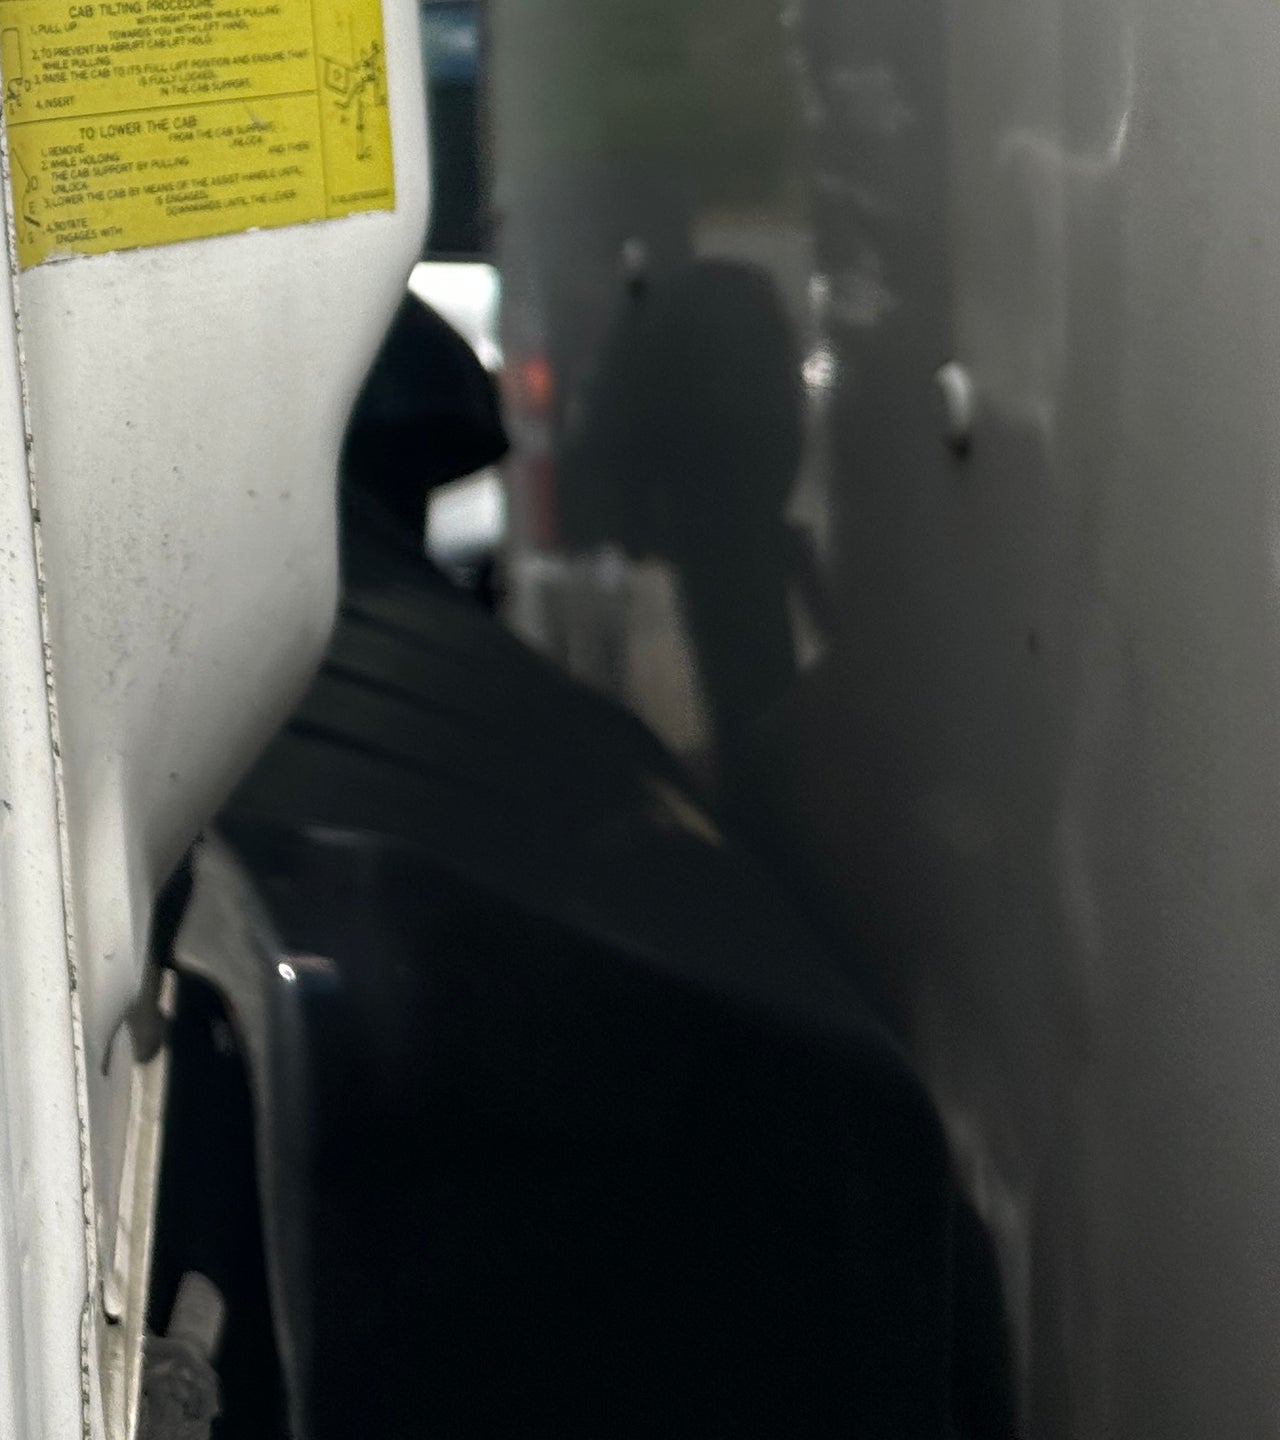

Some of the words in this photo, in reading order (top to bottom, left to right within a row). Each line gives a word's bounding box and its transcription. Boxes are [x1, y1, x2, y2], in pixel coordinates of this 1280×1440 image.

[68, 4, 95, 19] CAB
[98, 1, 143, 16] TILTING
[63, 21, 79, 32] UP
[41, 47, 53, 59] TO
[53, 44, 97, 57] PREVENT
[97, 43, 109, 54] AN
[42, 60, 69, 71] WHILE
[71, 56, 112, 69] PULLING
[42, 72, 69, 83] RAISE
[70, 70, 89, 81] THE
[91, 68, 111, 79] CAB
[113, 66, 126, 77] TO
[78, 126, 96, 140] TO
[99, 120, 142, 139] LOWER
[146, 118, 170, 133] THE
[172, 115, 199, 130] CAB
[51, 169, 69, 181] THE
[70, 168, 90, 179] CAB
[92, 162, 134, 176] SUPPORT
[87, 190, 105, 201] THE
[107, 188, 127, 200] CAB
